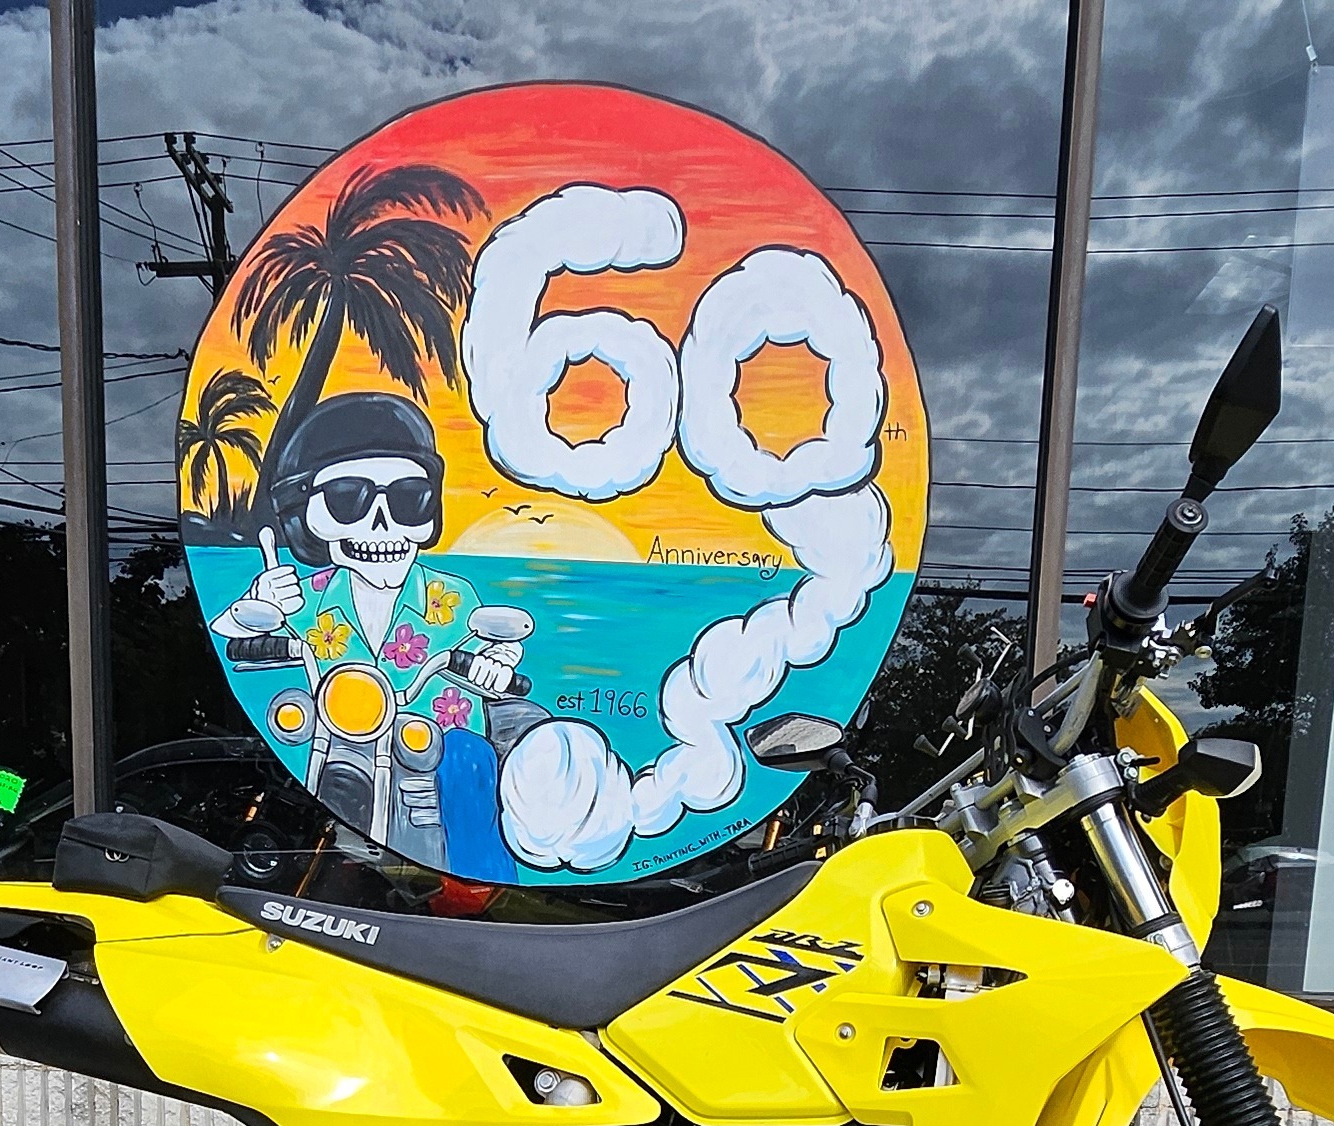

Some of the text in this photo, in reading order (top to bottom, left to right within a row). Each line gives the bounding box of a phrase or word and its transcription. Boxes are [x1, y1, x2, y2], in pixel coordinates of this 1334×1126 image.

[646, 535, 783, 580] Anniversary
[589, 688, 648, 718] 1966
[260, 901, 380, 945] SUZUKI
